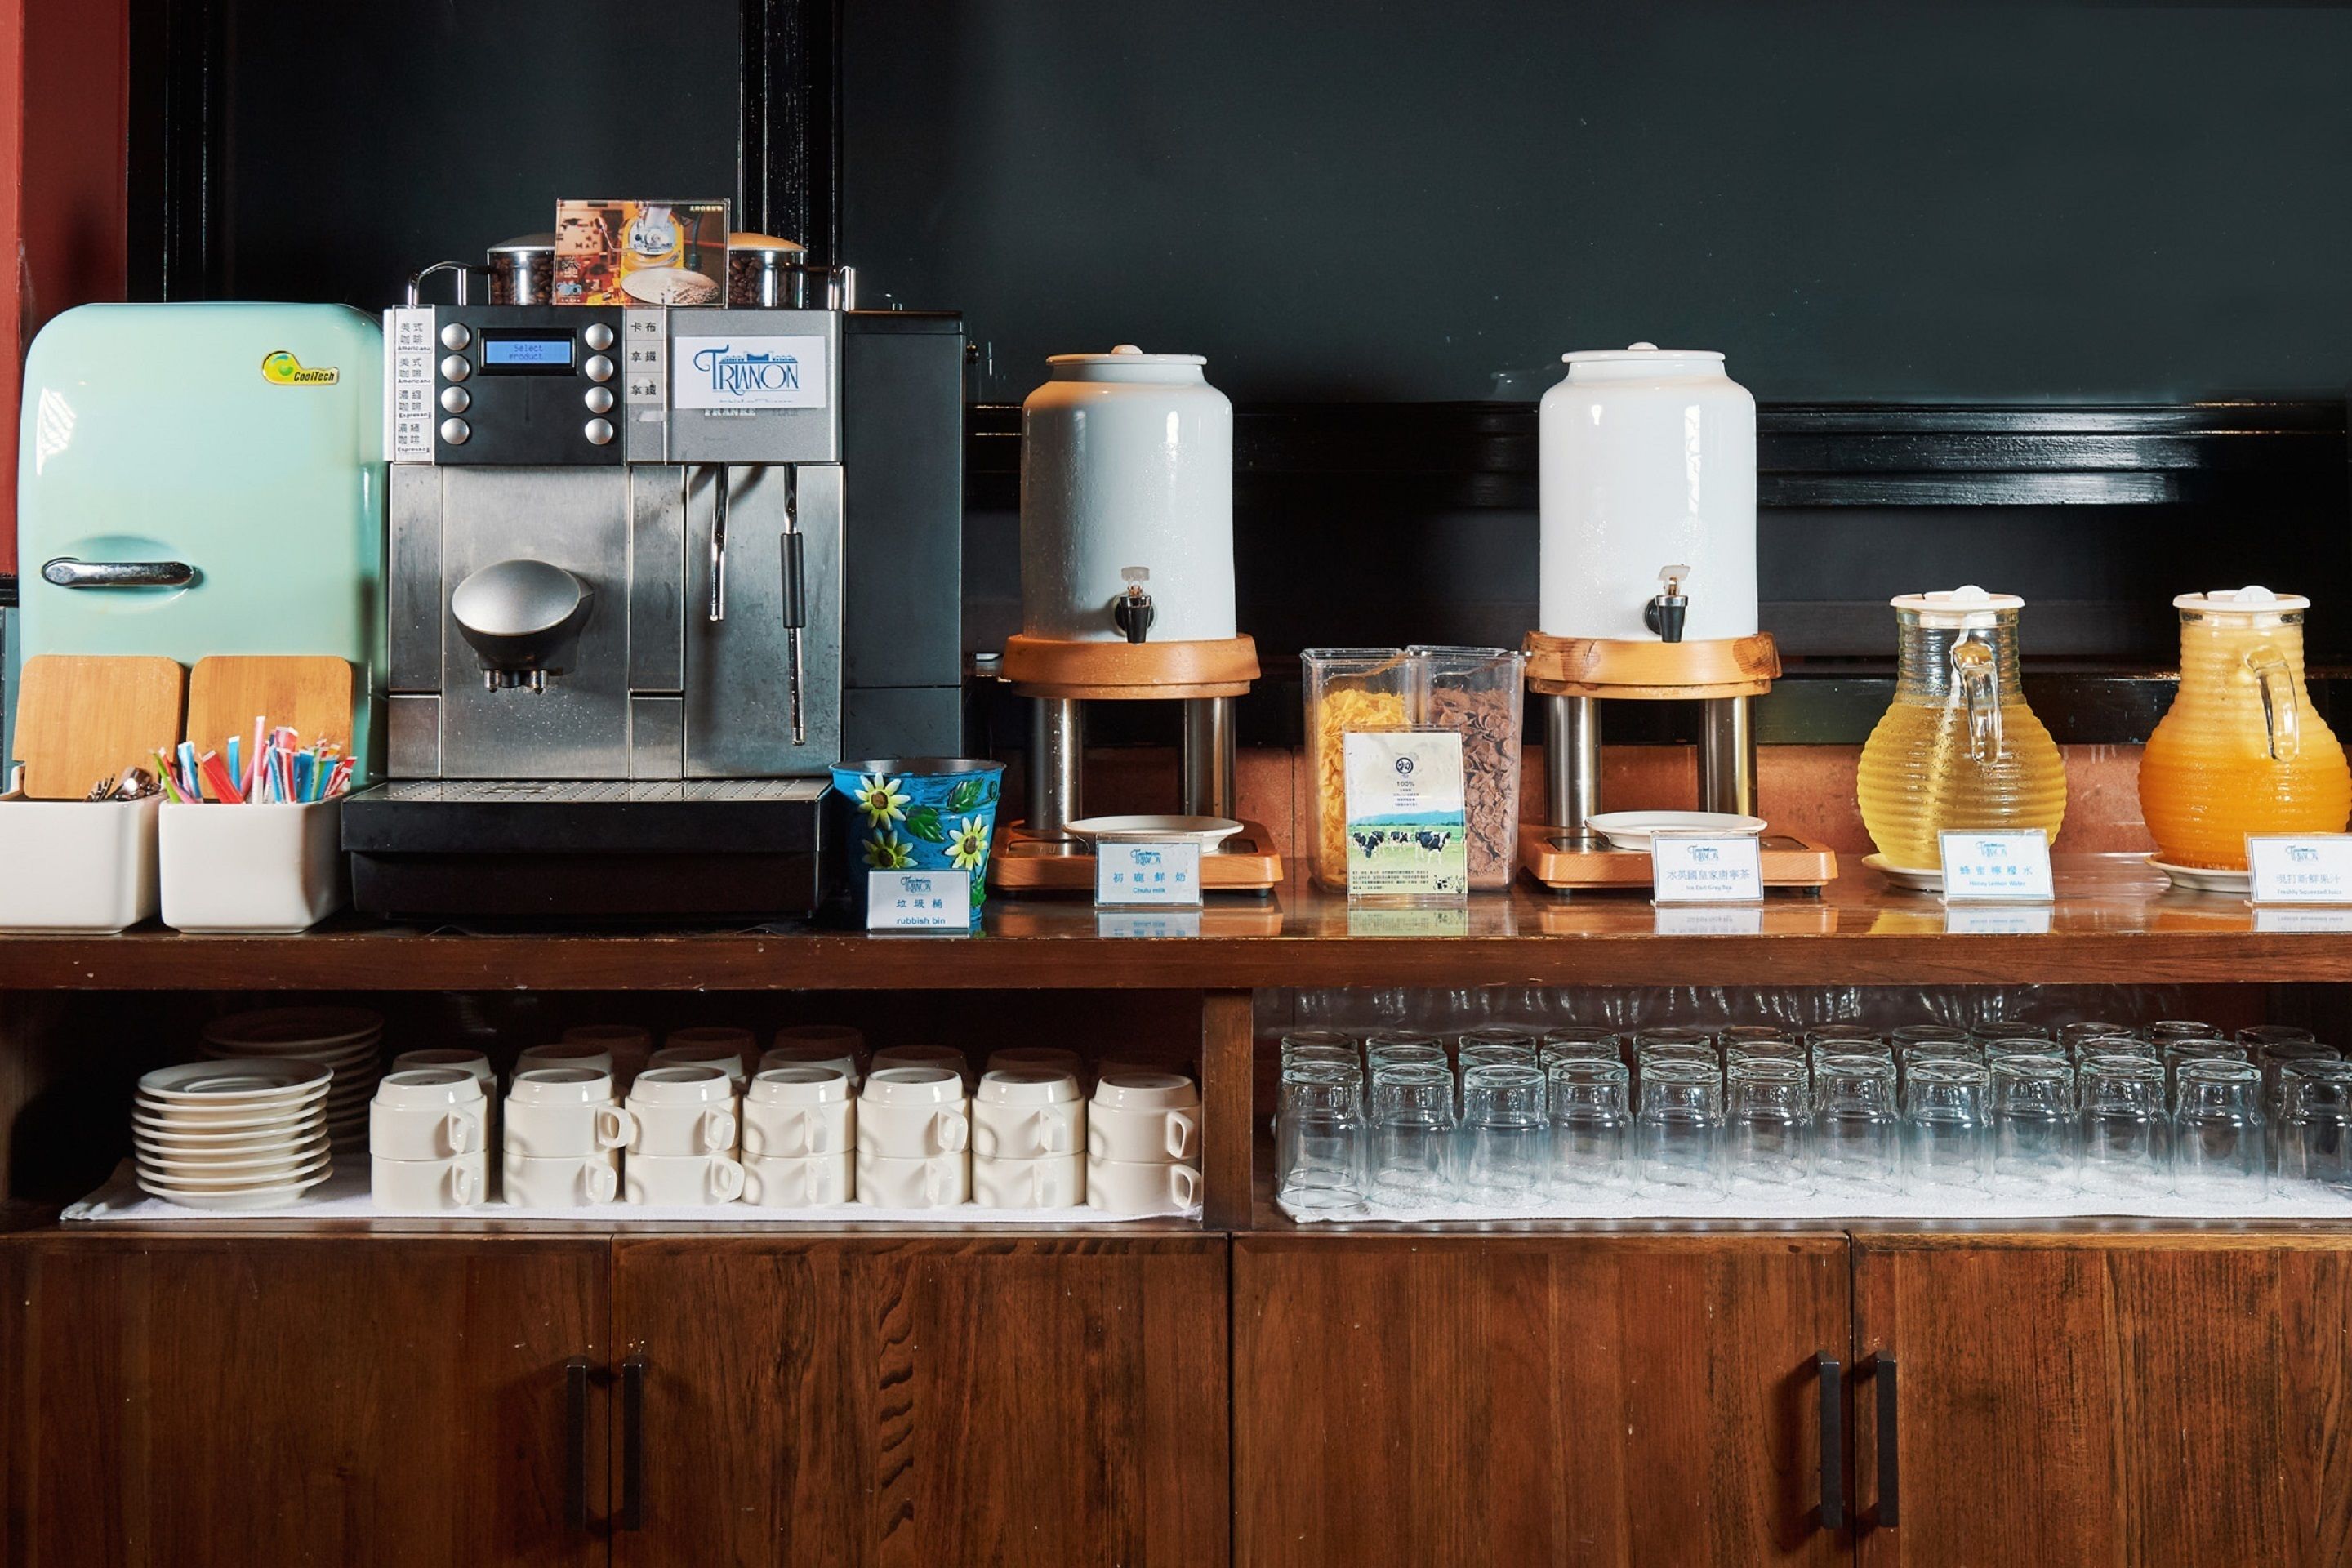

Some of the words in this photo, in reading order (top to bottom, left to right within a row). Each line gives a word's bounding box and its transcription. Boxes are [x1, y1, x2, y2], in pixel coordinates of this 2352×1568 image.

[630, 322, 657, 332] 卡布
[400, 335, 423, 344] 咖啡
[514, 344, 544, 352] Select
[630, 350, 657, 362] 拿鐵
[293, 371, 335, 382] CoolTech
[399, 369, 421, 377] 咖啡
[630, 384, 657, 395] 拿鐵
[399, 402, 421, 411] 咖啡
[398, 435, 420, 444] 咖啡
[1113, 872, 1186, 883] 初鹿鮮奶
